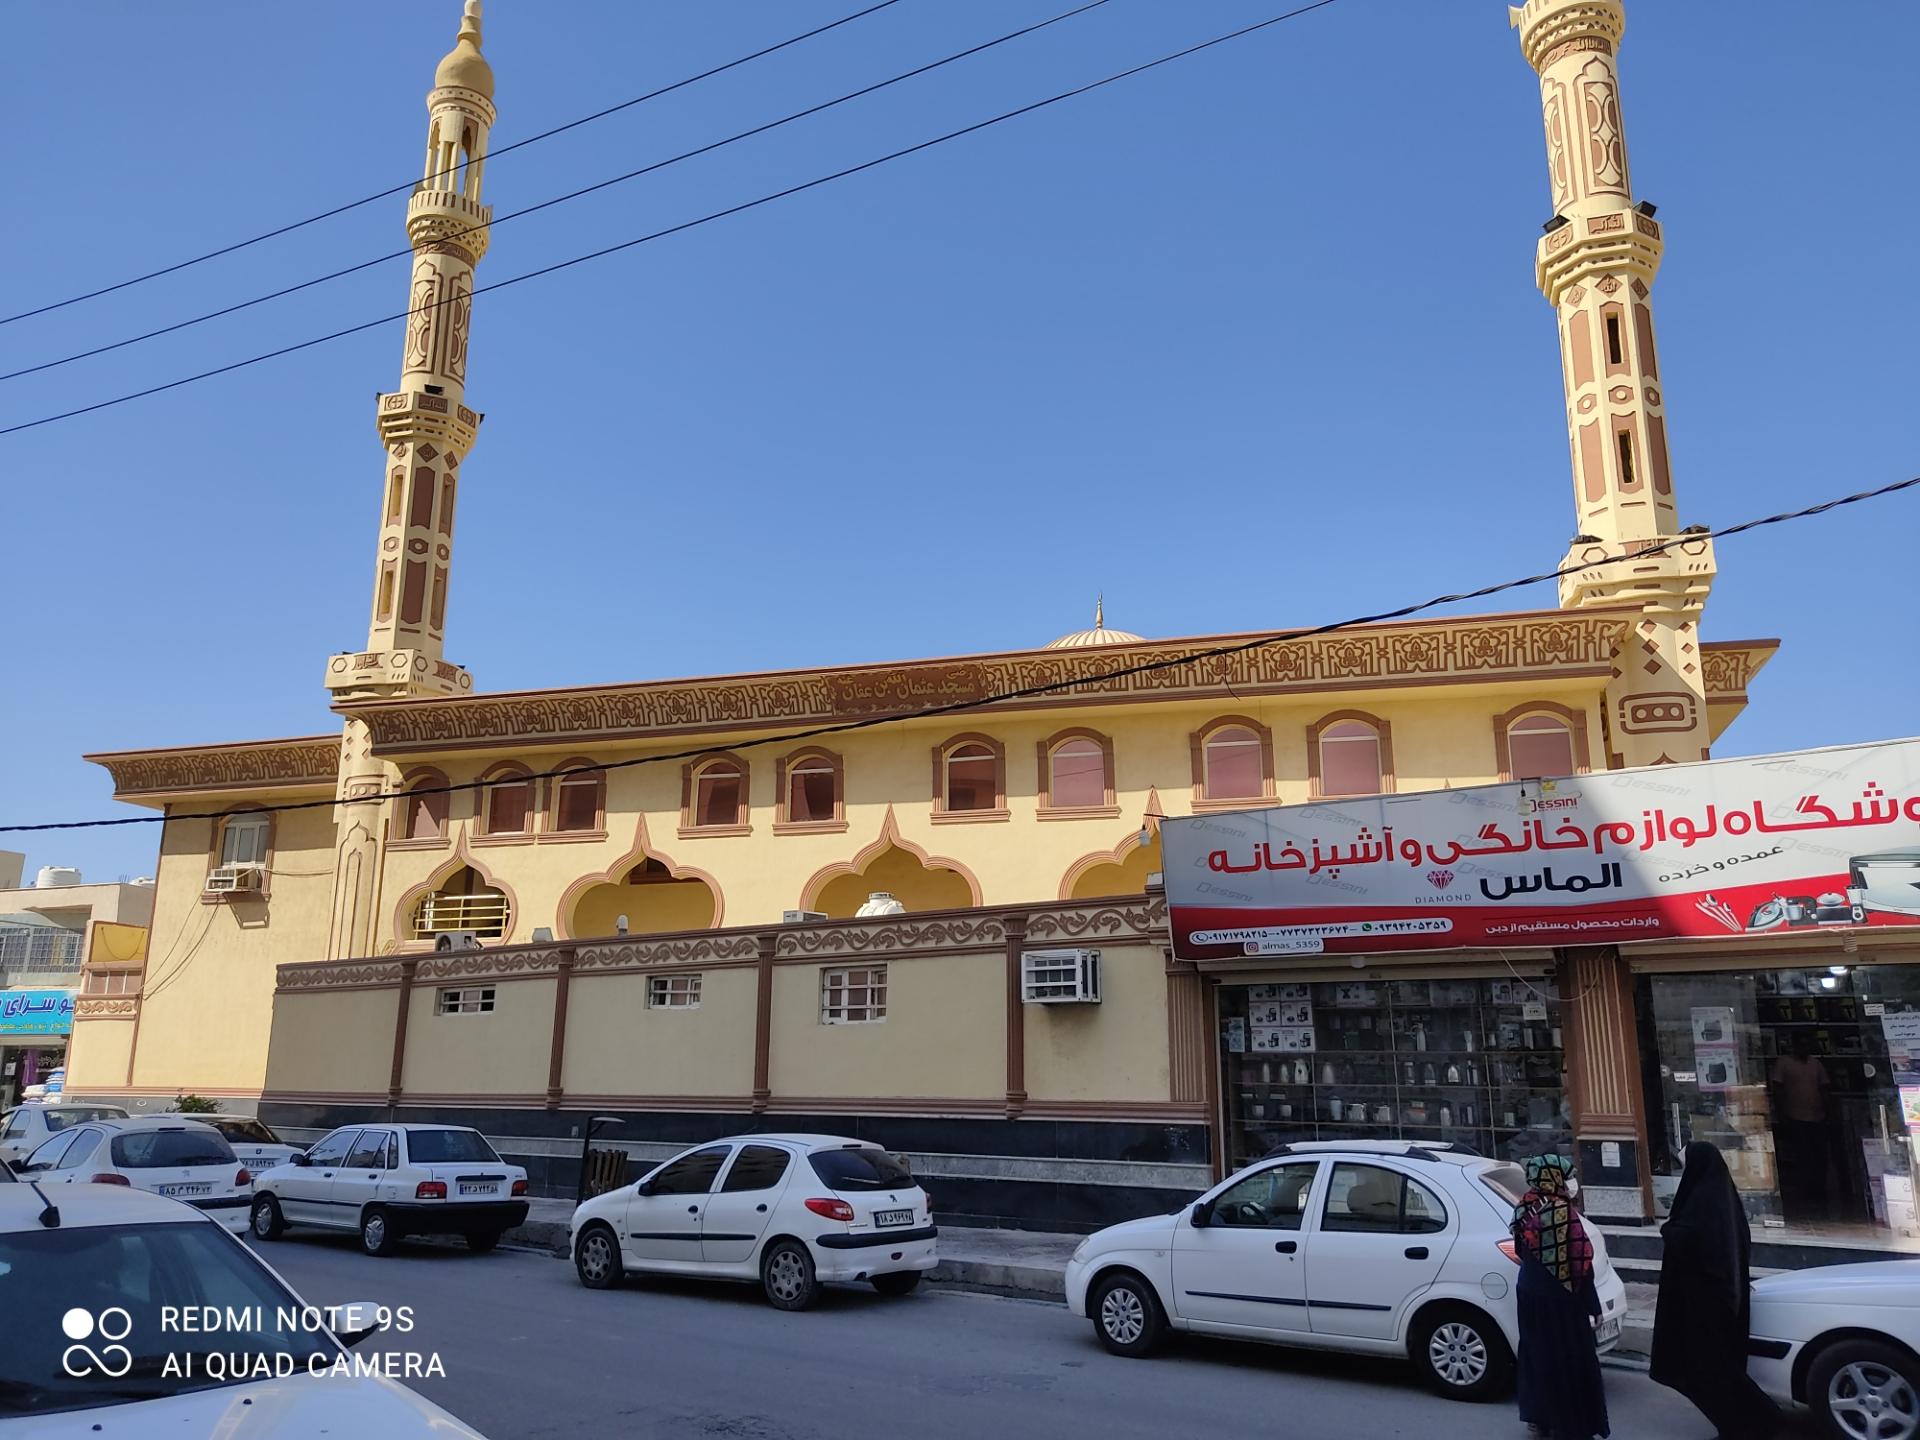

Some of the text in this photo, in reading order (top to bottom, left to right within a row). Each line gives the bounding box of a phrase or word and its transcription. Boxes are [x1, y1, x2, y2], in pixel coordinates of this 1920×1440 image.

[896, 678, 936, 700] عثمان
[937, 679, 975, 699] مسجد
[1426, 816, 1589, 866] خانگی
[1593, 804, 1718, 855] لوازم
[1208, 826, 1394, 880] آشپزخانه
[1400, 838, 1422, 868] و
[1658, 846, 1784, 883] عمده و خرده
[1480, 862, 1622, 901] الماس
[1415, 894, 1472, 904] DIAMOND
[1485, 916, 1660, 934] واردات محصول مستقیم از دبی
[1262, 940, 1321, 951] almas_5359
